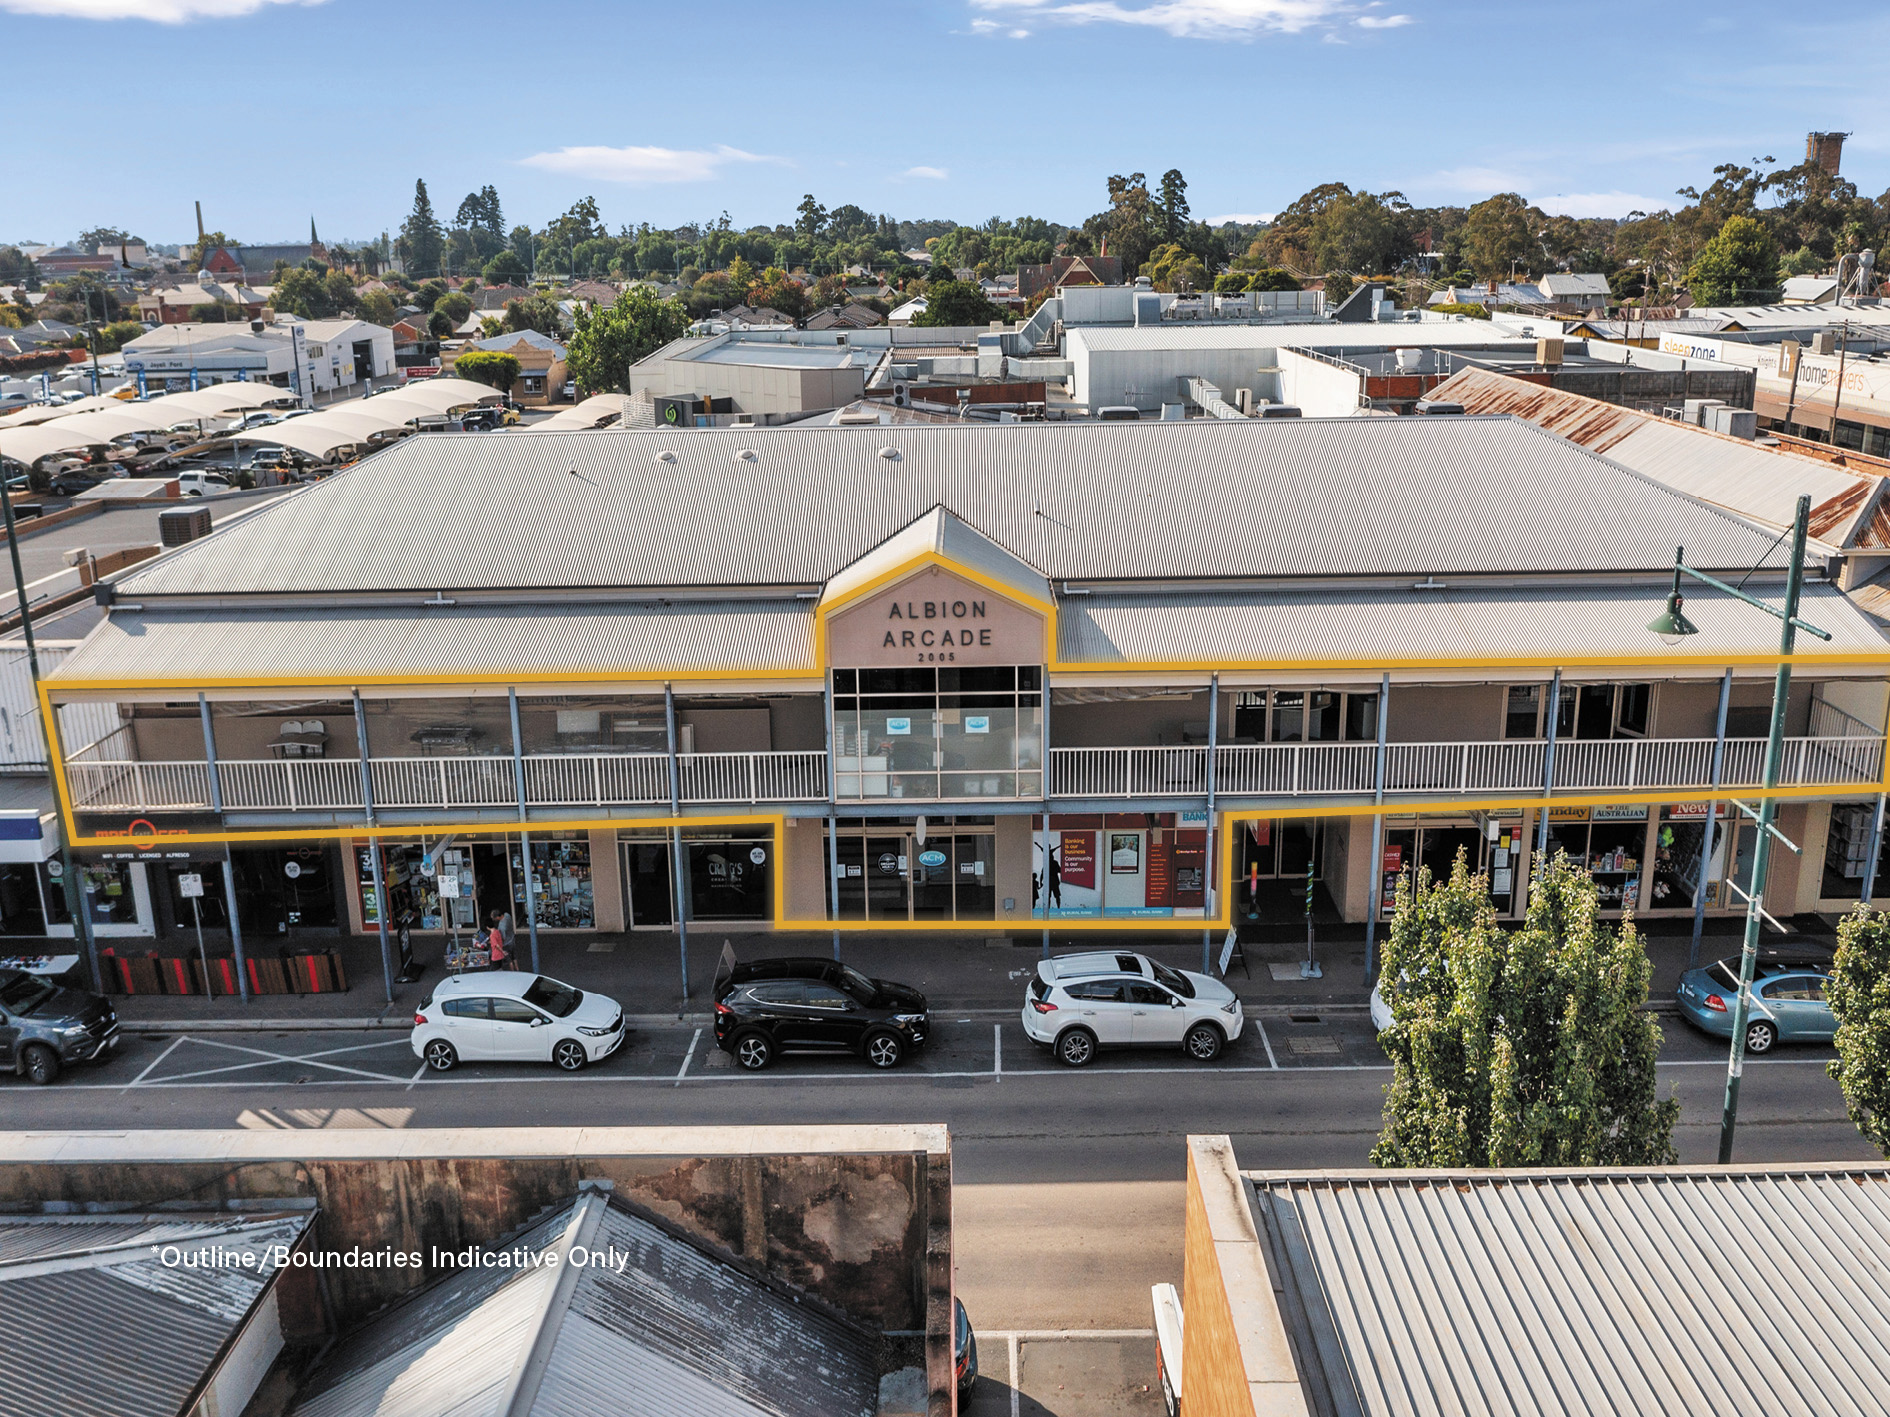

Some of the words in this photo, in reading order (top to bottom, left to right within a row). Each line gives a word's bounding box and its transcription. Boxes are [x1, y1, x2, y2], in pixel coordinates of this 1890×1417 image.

[1664, 338, 1716, 361] sleepzone
[889, 600, 985, 619] ALBION
[883, 629, 991, 647] ARCADE
[918, 652, 955, 662] 2005
[1595, 809, 1645, 817] AUSTRALIAN
[1677, 804, 1717, 814] New
[1183, 811, 1208, 821] BANK
[922, 853, 943, 861] ACM
[708, 862, 743, 875] CRAG'S
